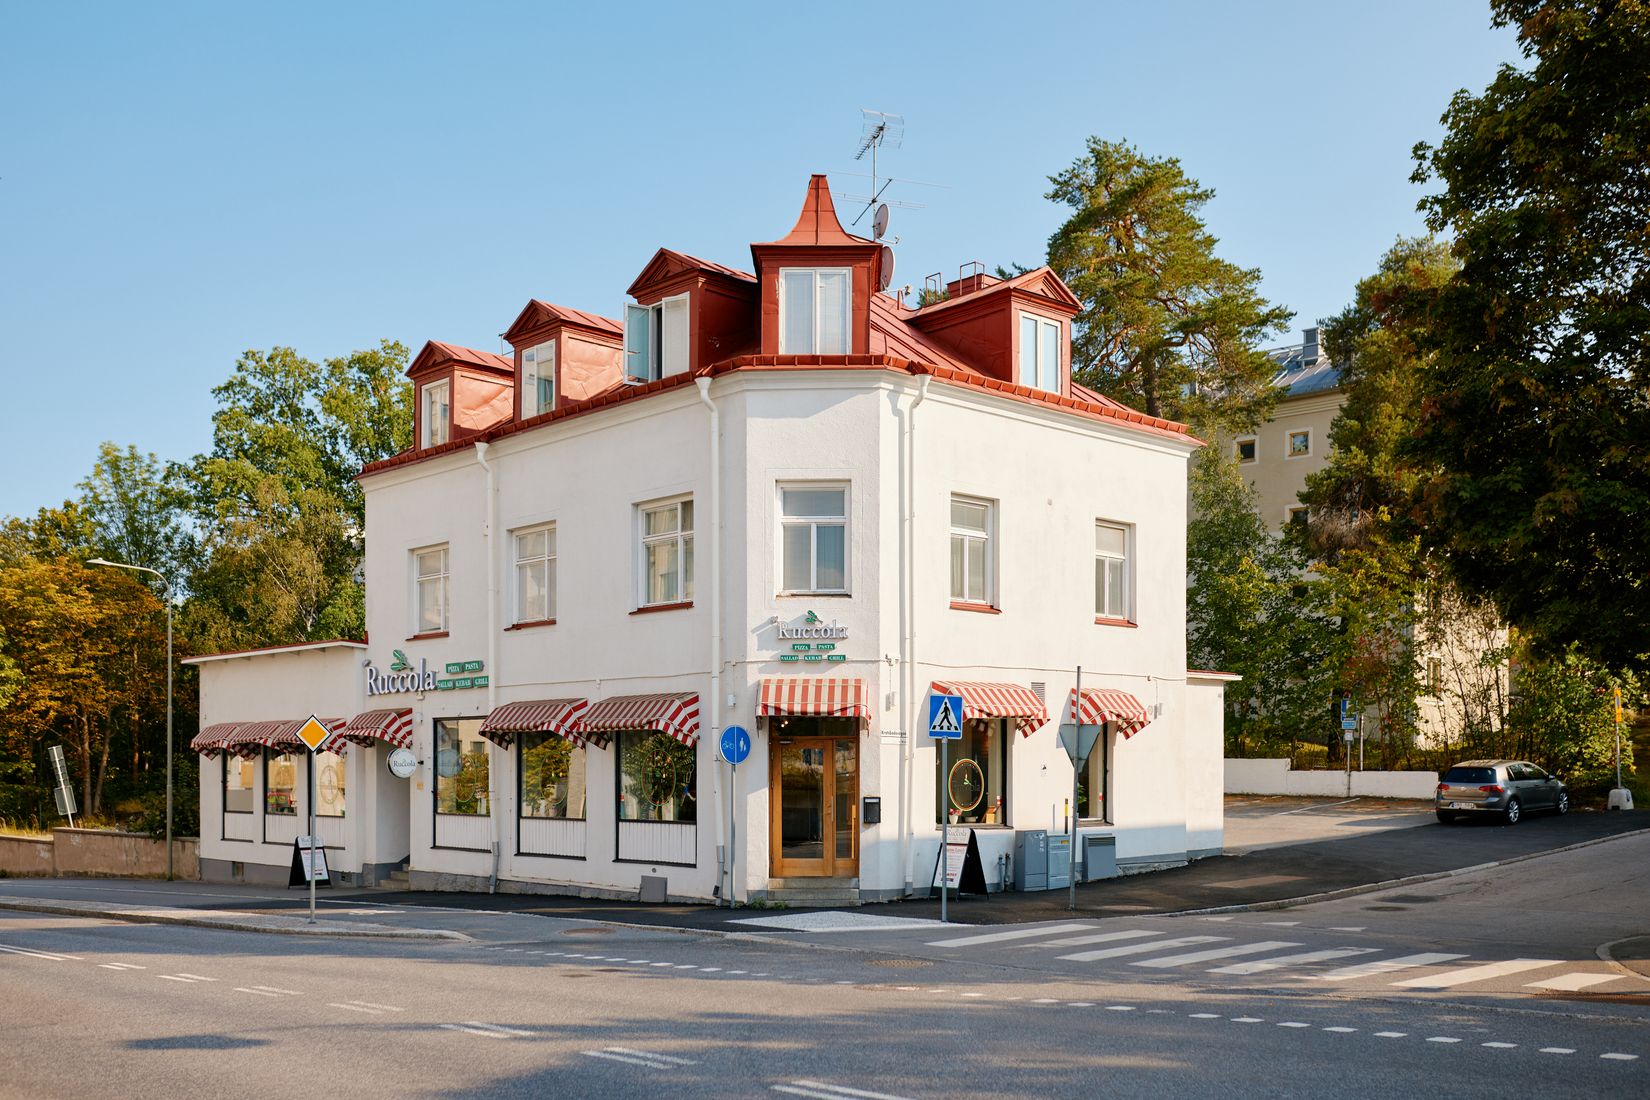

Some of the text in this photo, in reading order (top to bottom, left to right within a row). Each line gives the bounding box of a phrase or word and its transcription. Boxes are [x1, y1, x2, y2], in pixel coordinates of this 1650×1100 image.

[778, 619, 848, 639] Ruccola
[447, 662, 479, 673] PIZZA PASTA
[367, 657, 436, 696] Ruccola
[437, 680, 453, 689] SALLAD
